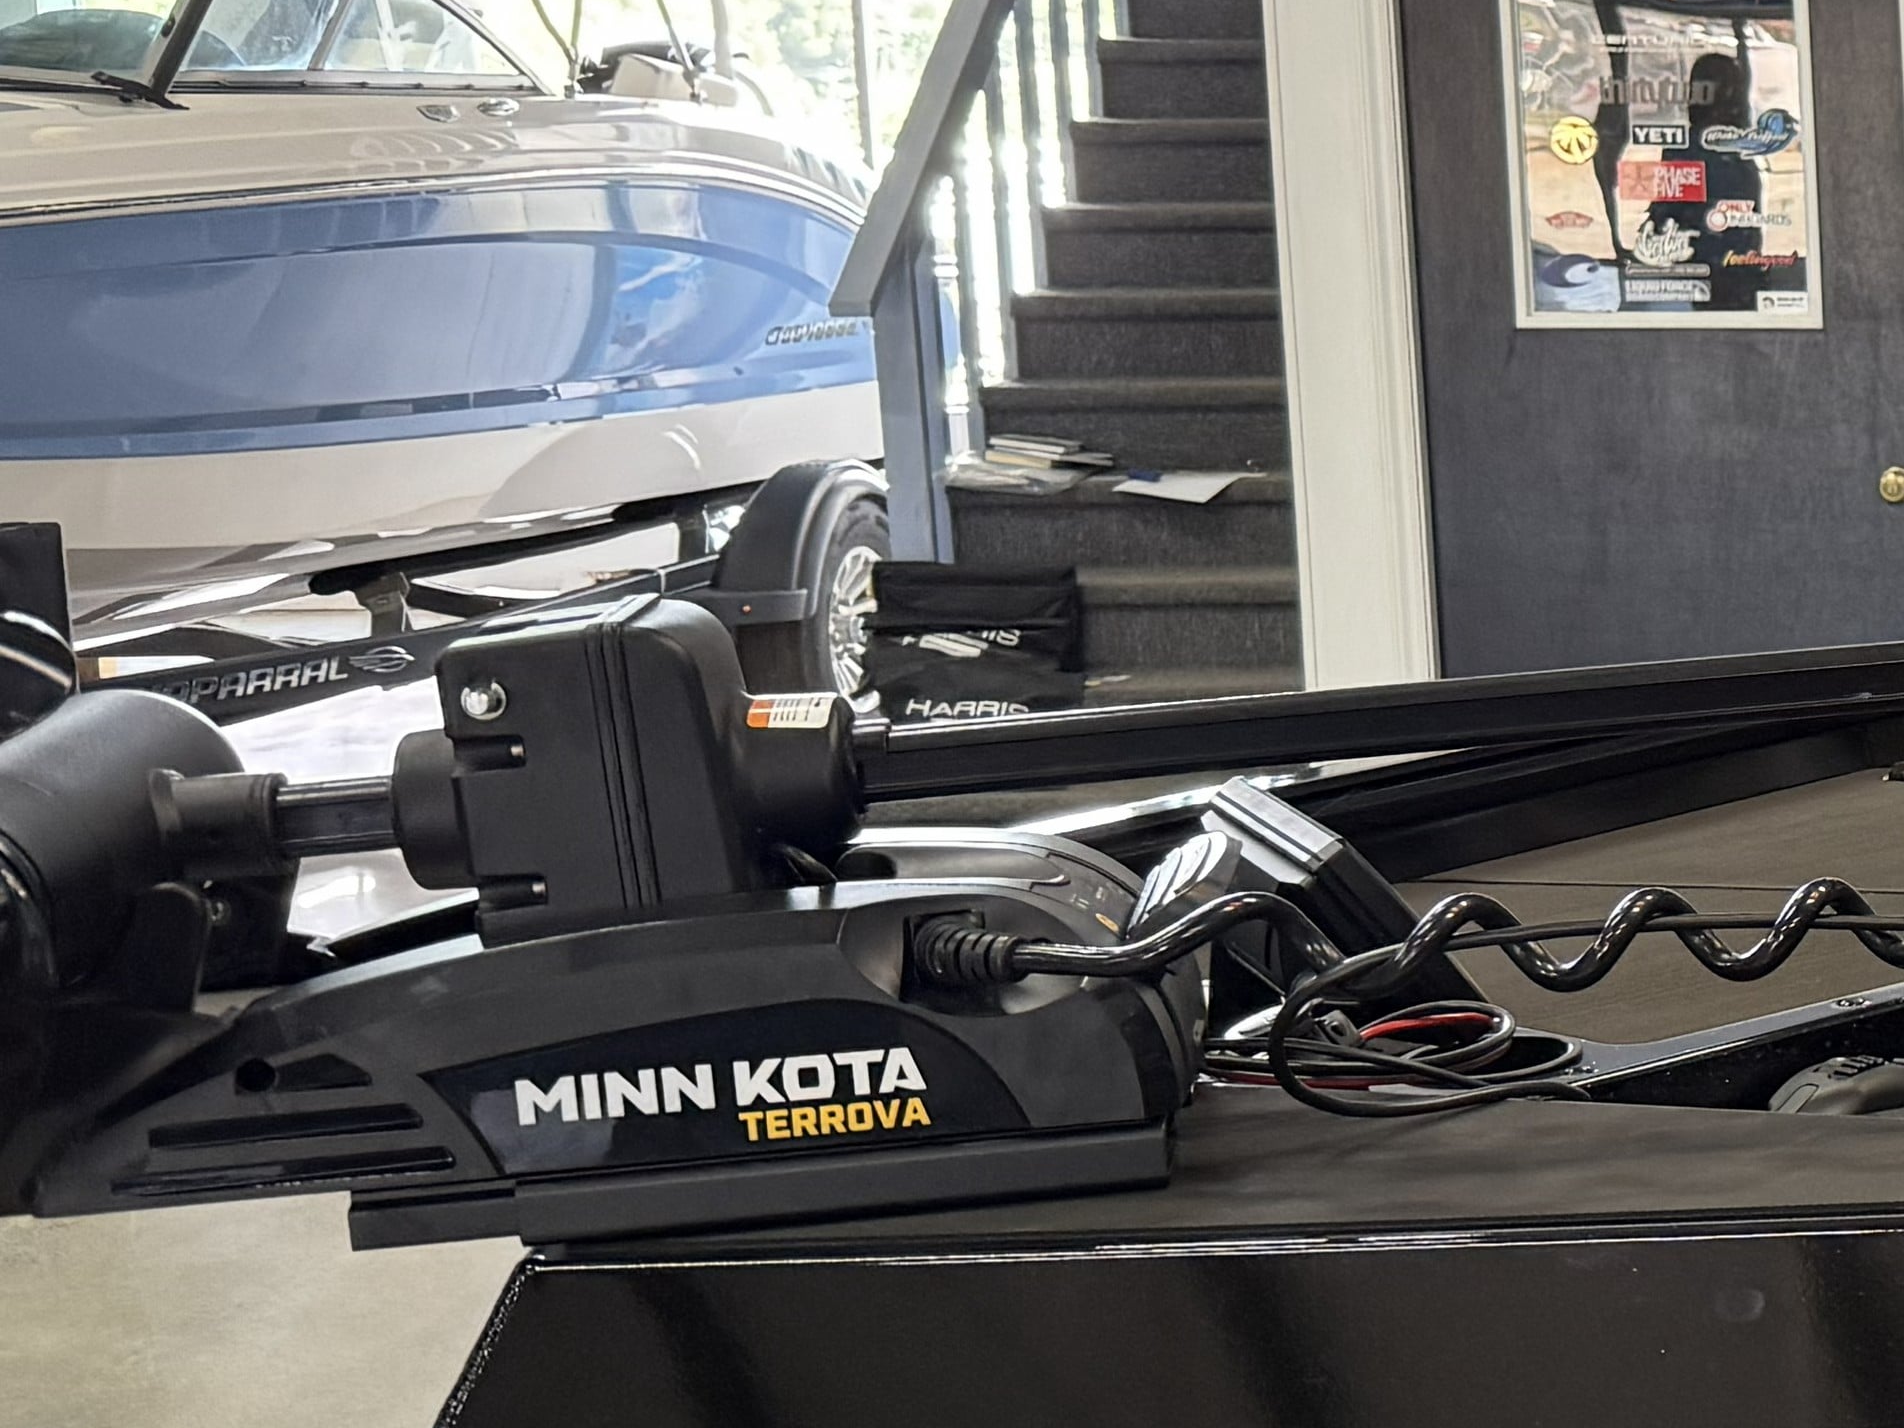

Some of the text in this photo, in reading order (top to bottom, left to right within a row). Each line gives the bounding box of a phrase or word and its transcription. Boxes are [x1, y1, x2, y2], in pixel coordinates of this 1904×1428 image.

[1634, 128, 1683, 143] YETI
[1655, 166, 1701, 186] PHASE
[1654, 182, 1684, 198] FIVE
[514, 1046, 928, 1126] MINN KOTA
[738, 1096, 932, 1142] TERROVA
